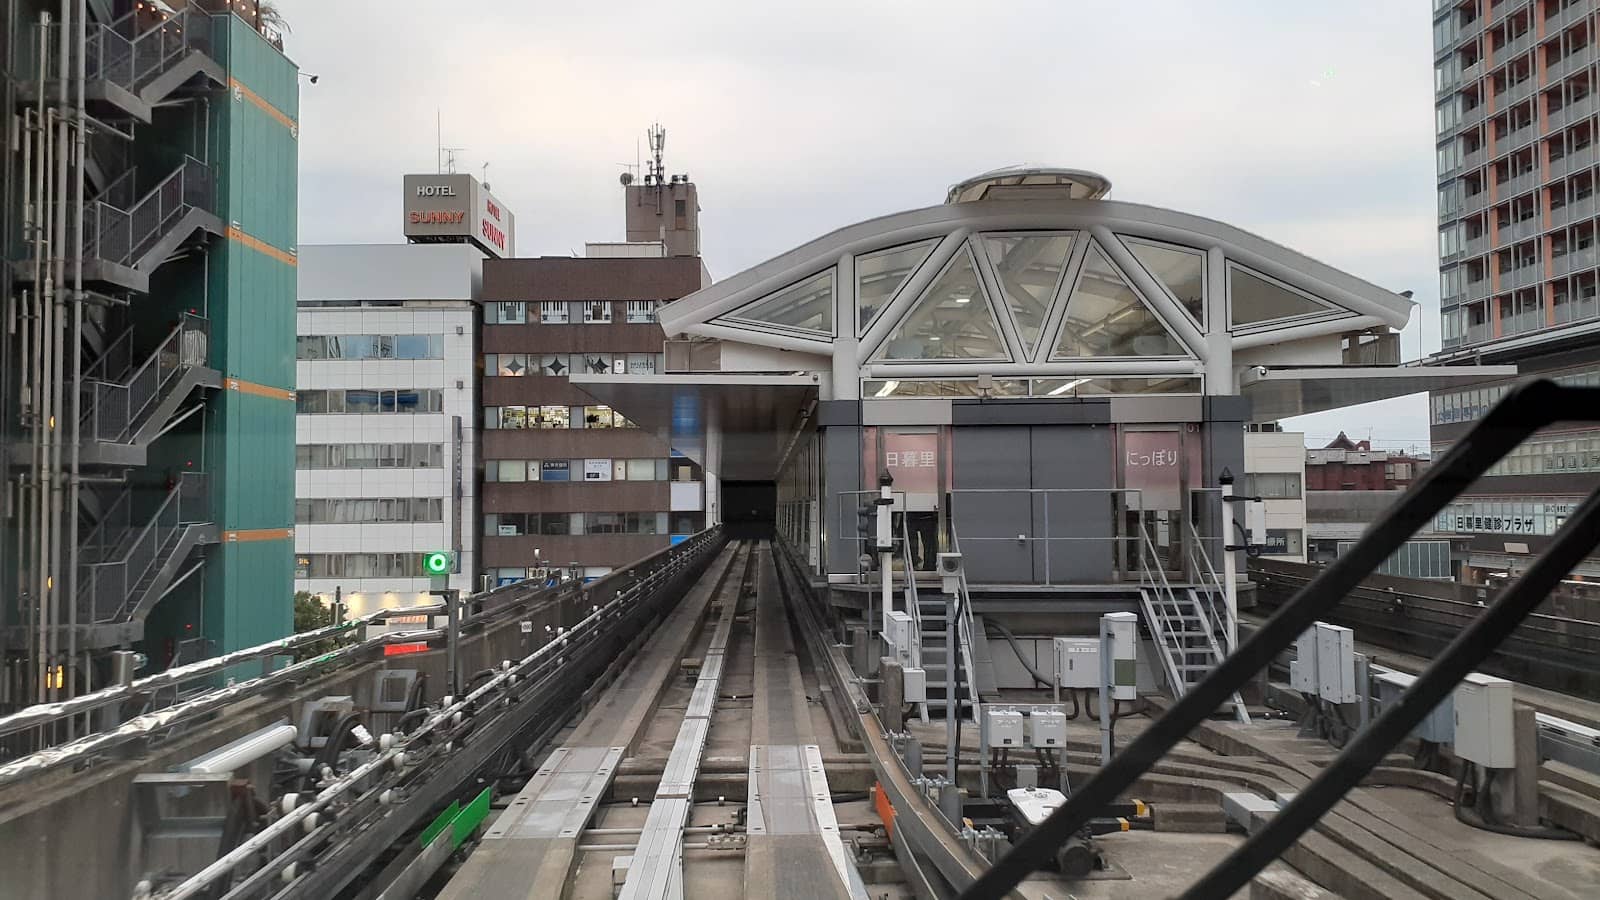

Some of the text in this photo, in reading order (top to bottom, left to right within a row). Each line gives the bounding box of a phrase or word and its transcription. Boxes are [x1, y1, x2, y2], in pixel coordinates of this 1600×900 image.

[416, 185, 456, 197] HOTEL
[409, 210, 465, 224] SUNNY
[482, 218, 505, 251] SUNNY
[886, 450, 936, 468] 日暮里
[1126, 448, 1177, 466] にっぽり
